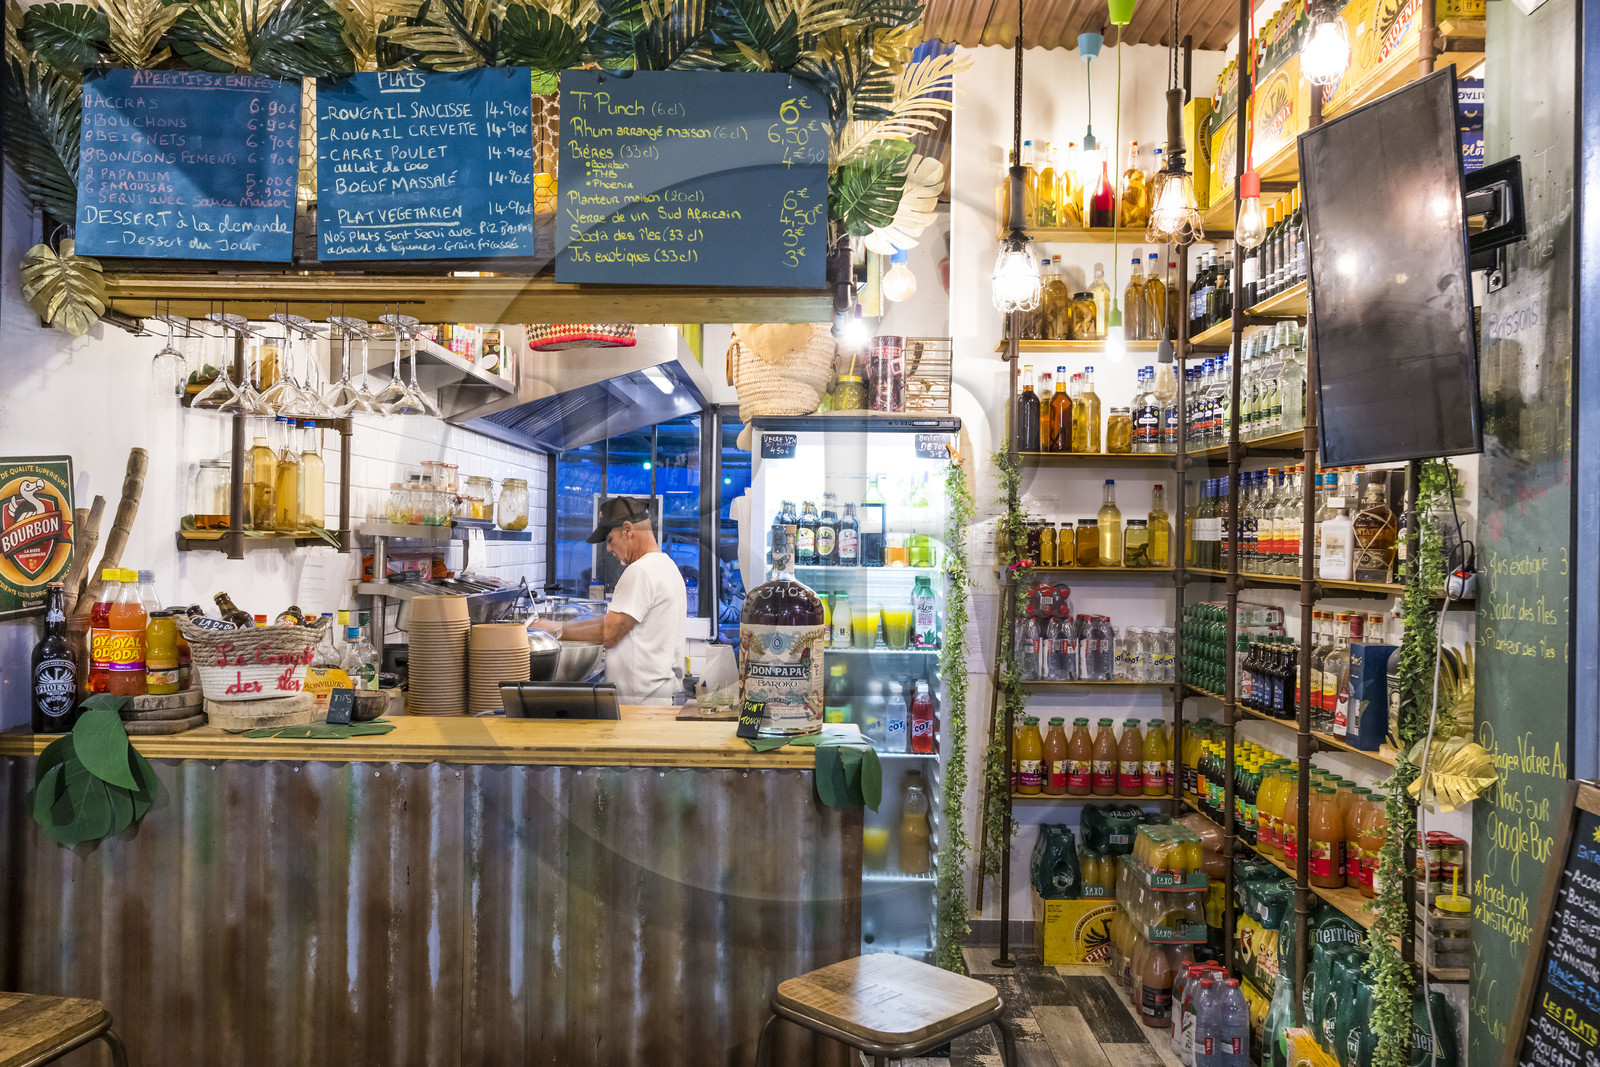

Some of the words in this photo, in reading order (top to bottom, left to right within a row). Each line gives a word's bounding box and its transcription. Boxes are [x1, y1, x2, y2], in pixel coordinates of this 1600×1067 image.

[378, 72, 425, 88] PLATS
[94, 96, 159, 109] ACCRAS
[411, 102, 472, 118] SAUCISSE
[570, 91, 592, 110] Ti
[594, 92, 644, 116] Punch
[94, 114, 187, 128] BOUCHONS
[570, 116, 613, 138] Rhum
[616, 125, 663, 140] arrangé
[667, 129, 711, 138] maison
[409, 122, 478, 136] CREVETTE
[97, 131, 186, 146] BEIGNETS
[84, 148, 93, 162] 8
[97, 150, 176, 164] BONBONS
[182, 153, 236, 164] PIMENTS
[392, 146, 447, 159] POULET
[568, 140, 614, 159] Bières
[382, 162, 400, 172] de
[592, 170, 618, 178] THB
[101, 169, 169, 182] PAPADUM
[336, 178, 387, 194] BOEUF
[392, 170, 458, 191] MASSALÉ
[592, 180, 634, 189] Phoenix
[568, 190, 620, 205] Planteur
[624, 194, 661, 202] maison
[82, 206, 172, 227] DESSERT
[177, 212, 187, 227] à
[192, 215, 213, 232] la
[219, 214, 292, 234] demande
[338, 209, 374, 224] PLAT
[378, 206, 462, 222] VEGETARIEN
[566, 208, 607, 224] Verre
[612, 211, 626, 223] de
[632, 212, 650, 221] vin
[658, 207, 682, 220] Sud
[687, 210, 742, 221] Africain
[449, 228, 476, 237] avec
[570, 224, 609, 242] Soda
[614, 229, 635, 241] des
[123, 232, 183, 246] Dessert
[189, 236, 212, 249] du
[375, 241, 389, 252] de
[568, 246, 591, 262] Jus
[595, 247, 650, 266] exotiques
[1, 472, 9, 480] DE
[10, 465, 34, 475] QUALITE
[35, 466, 68, 489] SUPERIEURE
[1, 517, 59, 553] BOURBON
[1519, 598, 1534, 621] des
[216, 643, 246, 666] Le
[1522, 642, 1536, 657] des
[753, 666, 772, 675] DON
[775, 667, 801, 675] PAPA
[36, 684, 76, 695] PHOENIX
[225, 671, 262, 694] des
[758, 681, 797, 689] BAROKO
[889, 721, 903, 731] COT
[915, 722, 929, 732] COT
[1085, 887, 1103, 896] SAXO
[1543, 992, 1562, 1019] LES
[1564, 1008, 1598, 1045] PLATS
